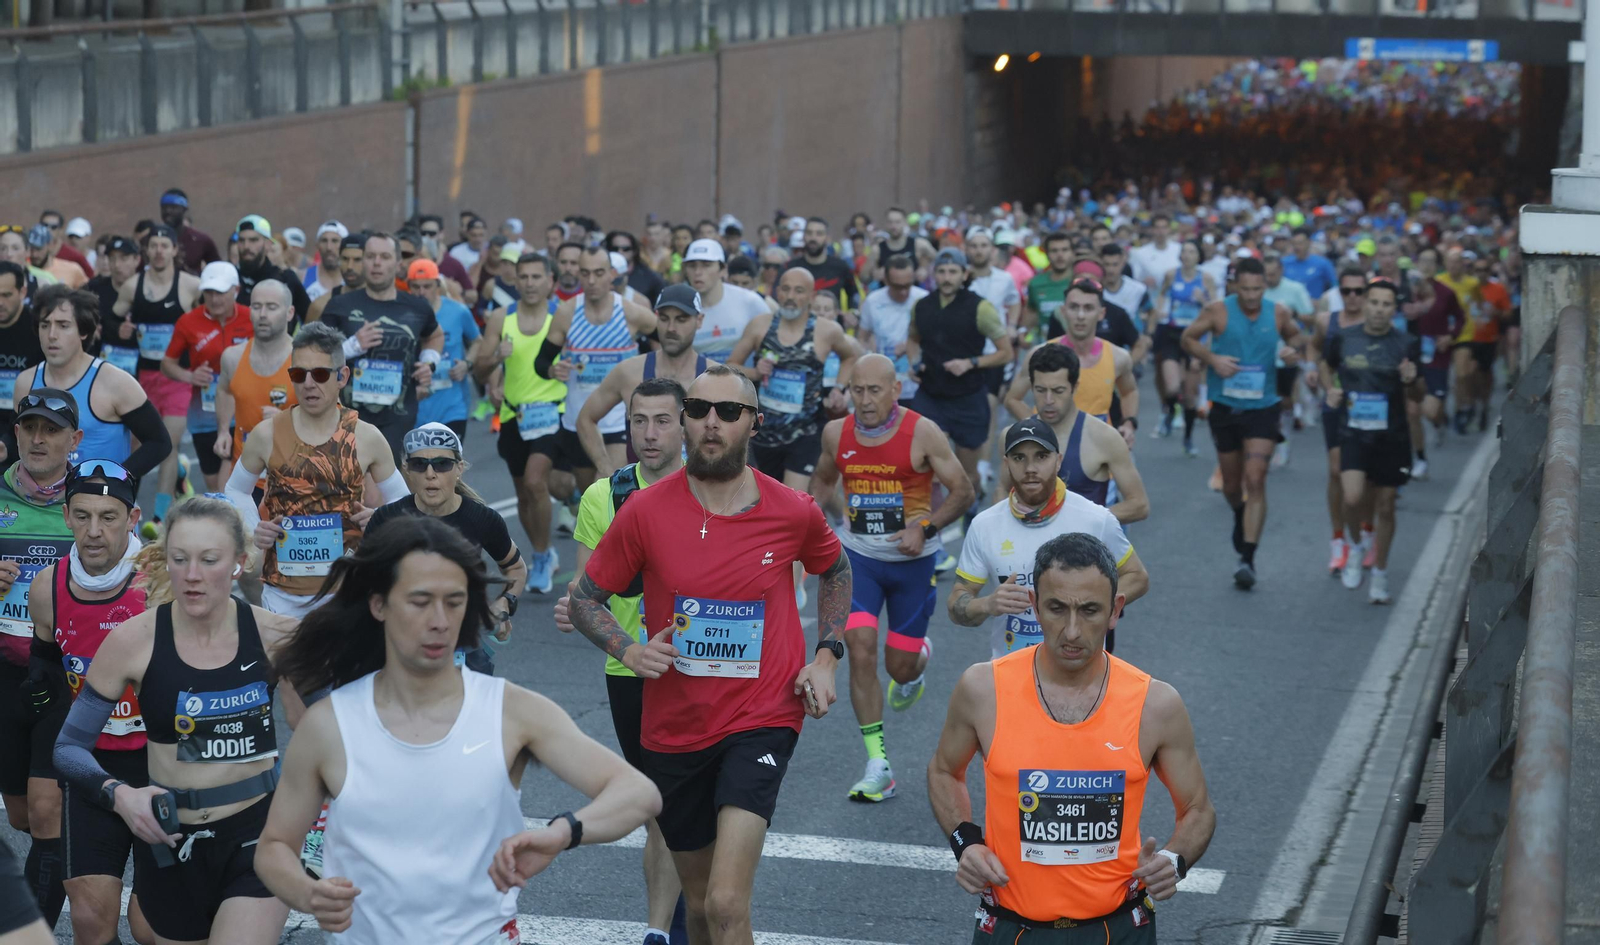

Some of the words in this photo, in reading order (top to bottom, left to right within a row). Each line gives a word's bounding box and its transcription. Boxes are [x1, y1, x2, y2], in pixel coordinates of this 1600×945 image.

[845, 463, 897, 474] ESPAÑA
[872, 480, 904, 494] LUNA
[863, 497, 896, 505] ZURICH
[865, 512, 884, 520] 3578
[296, 517, 334, 528] ZURICH
[866, 522, 885, 533] PAI
[298, 536, 318, 545] 5362
[28, 545, 57, 555] CCRD
[289, 548, 330, 561] OSCAR
[705, 604, 754, 616] ZURICH
[704, 627, 730, 638] 6711
[685, 640, 748, 659] TOMMY
[209, 688, 260, 710] ZURICH
[213, 721, 244, 734] 4038
[201, 735, 256, 759] JODIE
[1055, 776, 1113, 789] ZURICH
[1056, 803, 1086, 817] 3461
[1023, 820, 1118, 842] VASILEIOS
